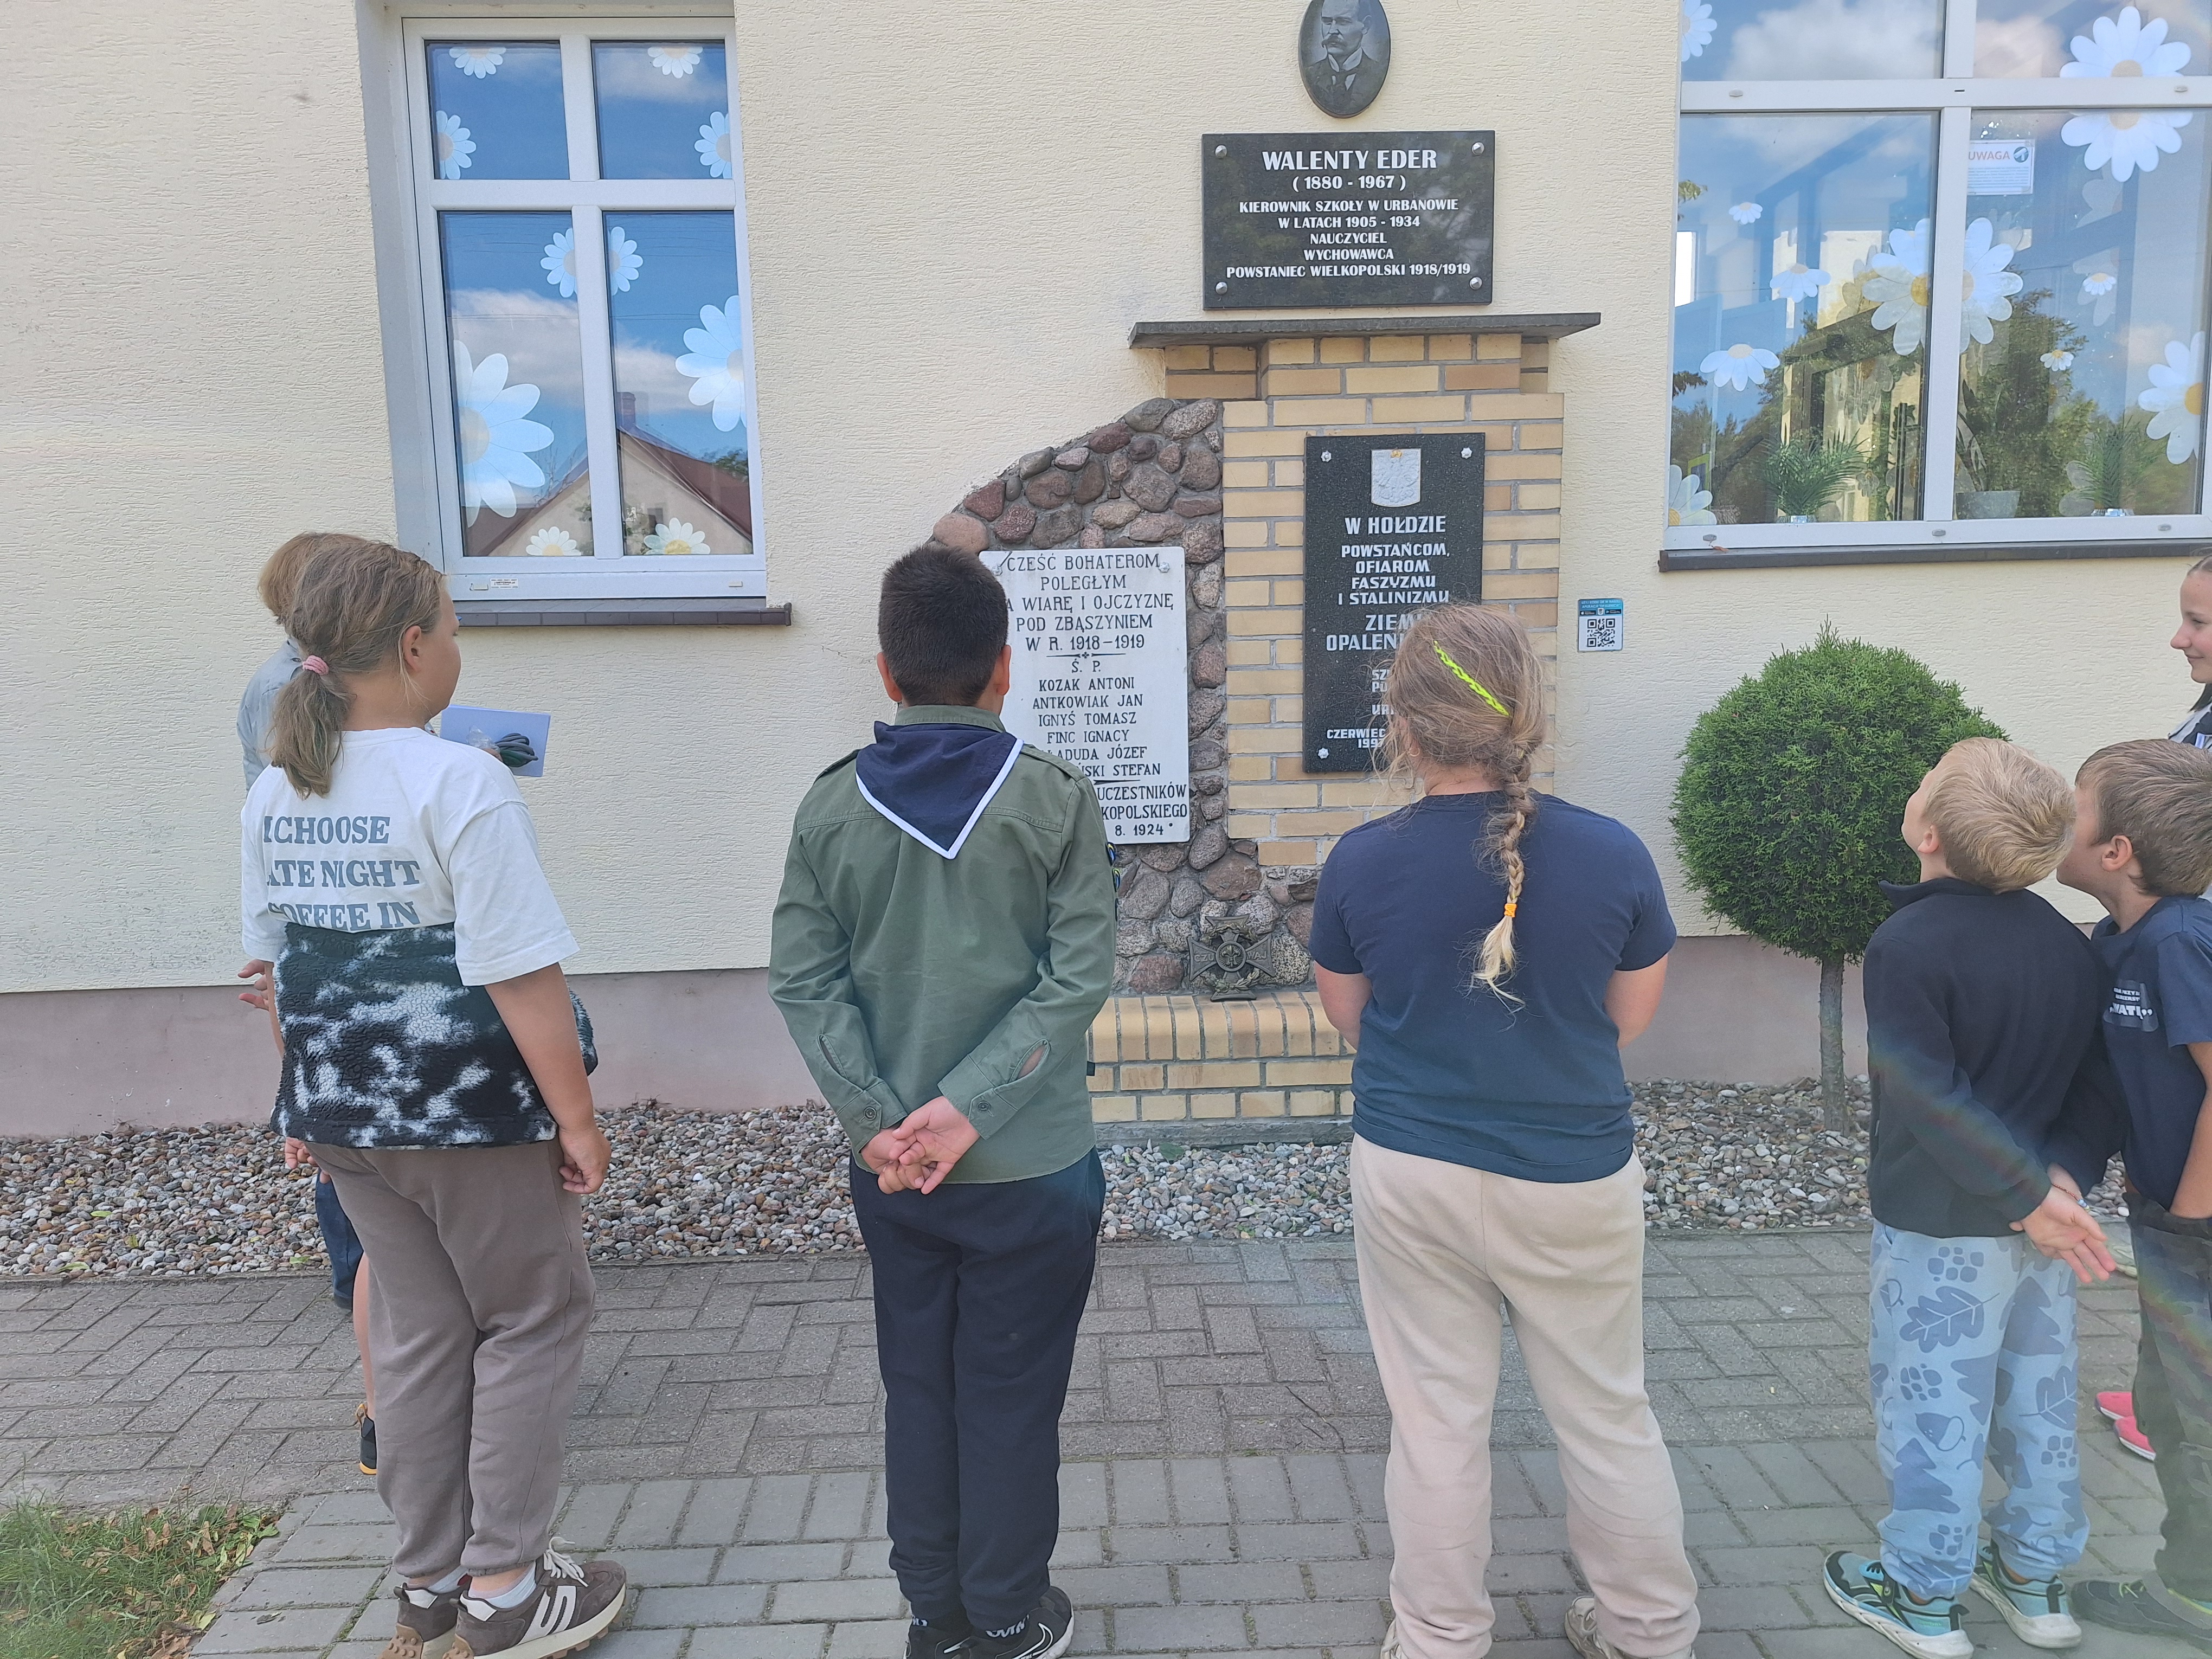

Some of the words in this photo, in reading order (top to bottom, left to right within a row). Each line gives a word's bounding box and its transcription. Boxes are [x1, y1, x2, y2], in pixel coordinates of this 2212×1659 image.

[1262, 150, 1369, 171] WALENTY
[1377, 149, 1437, 169] EDER
[1969, 151, 2010, 160] UWAGA
[1304, 176, 1342, 190] 1880
[1358, 175, 1394, 189] 1967
[1239, 201, 1311, 213] KIEROWNIK
[1315, 200, 1363, 212] SZKOŁY
[1368, 200, 1380, 211] W
[1384, 199, 1459, 211] URBANOWIE
[1278, 217, 1290, 229] W
[1294, 217, 1342, 229] LATACH
[1345, 217, 1377, 228] 1905
[1390, 216, 1420, 227] 1934
[1310, 233, 1387, 245] NAUCZYCIEL
[1303, 249, 1394, 261] WYCHOWAWCA
[1226, 266, 1306, 278] POWSTANIEC
[1310, 265, 1405, 277] WIELKOPOLSKI
[1409, 263, 1471, 277] 1918/1919
[1345, 517, 1361, 535] W
[1368, 516, 1446, 534] HOŁDZIE
[1341, 543, 1450, 558] POWSTAŃCOM,
[1007, 552, 1056, 571] CZEŚĆ
[1065, 553, 1160, 570] BOHATEROM
[1355, 560, 1430, 574] OFIAROM
[1041, 575, 1127, 591] POLEGŁYM
[1352, 575, 1436, 589] FASZYZMU
[1006, 597, 1014, 612] A
[1022, 596, 1073, 613] WIARĘ
[1081, 596, 1085, 610] I
[1094, 593, 1174, 610] OJCZYZNĘ
[1338, 593, 1343, 605] I
[1349, 590, 1449, 605] STALINIZMU
[1017, 617, 1046, 632] POD
[1056, 614, 1153, 633] ZBĄSZYNIEM
[1025, 636, 1041, 651] W
[1049, 636, 1063, 651] R.
[1071, 658, 1082, 673] Ś.
[1092, 660, 1101, 672] P.
[1039, 678, 1081, 692] KOZAK
[1088, 677, 1135, 690] ANTONI
[1032, 695, 1109, 710] ANTKOWIAK
[1117, 694, 1143, 707] JAN
[1039, 710, 1076, 727] IGNYŚ
[1084, 712, 1136, 725] TOMASZ
[1047, 731, 1076, 744] FINC
[1084, 729, 1130, 743] IGNACY
[1327, 728, 1386, 739] CZERWIEC
[1107, 743, 1148, 760] JÓZEF
[1113, 763, 1161, 776] STEFAN
[1097, 781, 1187, 800] UCZESTNIKÓW
[1133, 824, 1164, 836] 1924
[320, 859, 420, 888] NIGHT
[377, 901, 421, 929] IN
